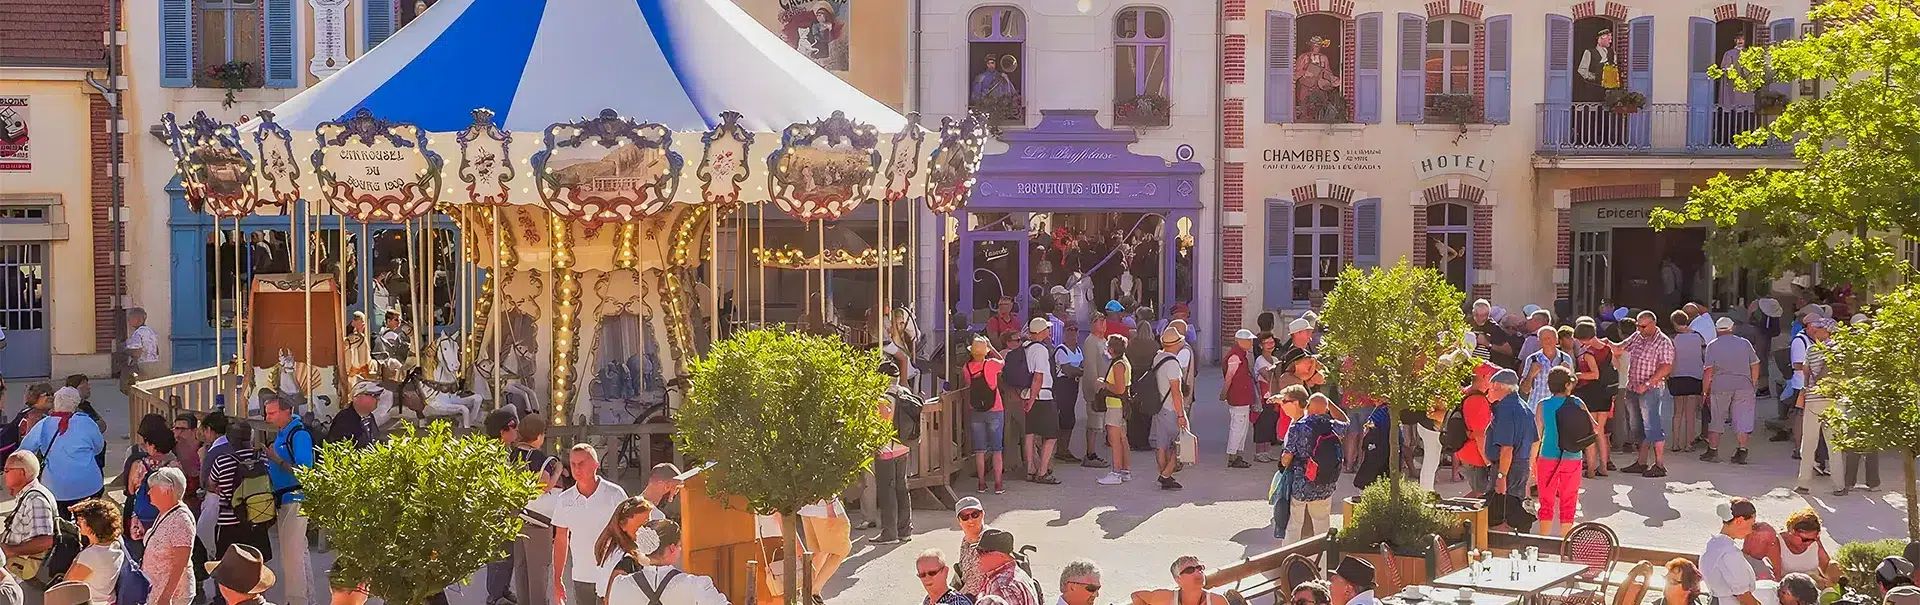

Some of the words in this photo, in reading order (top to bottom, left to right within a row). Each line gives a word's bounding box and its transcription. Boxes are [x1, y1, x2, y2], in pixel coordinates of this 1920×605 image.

[1263, 149, 1341, 162] CHAMBRES
[1421, 154, 1487, 173] HOTEL
[365, 166, 380, 175] DU
